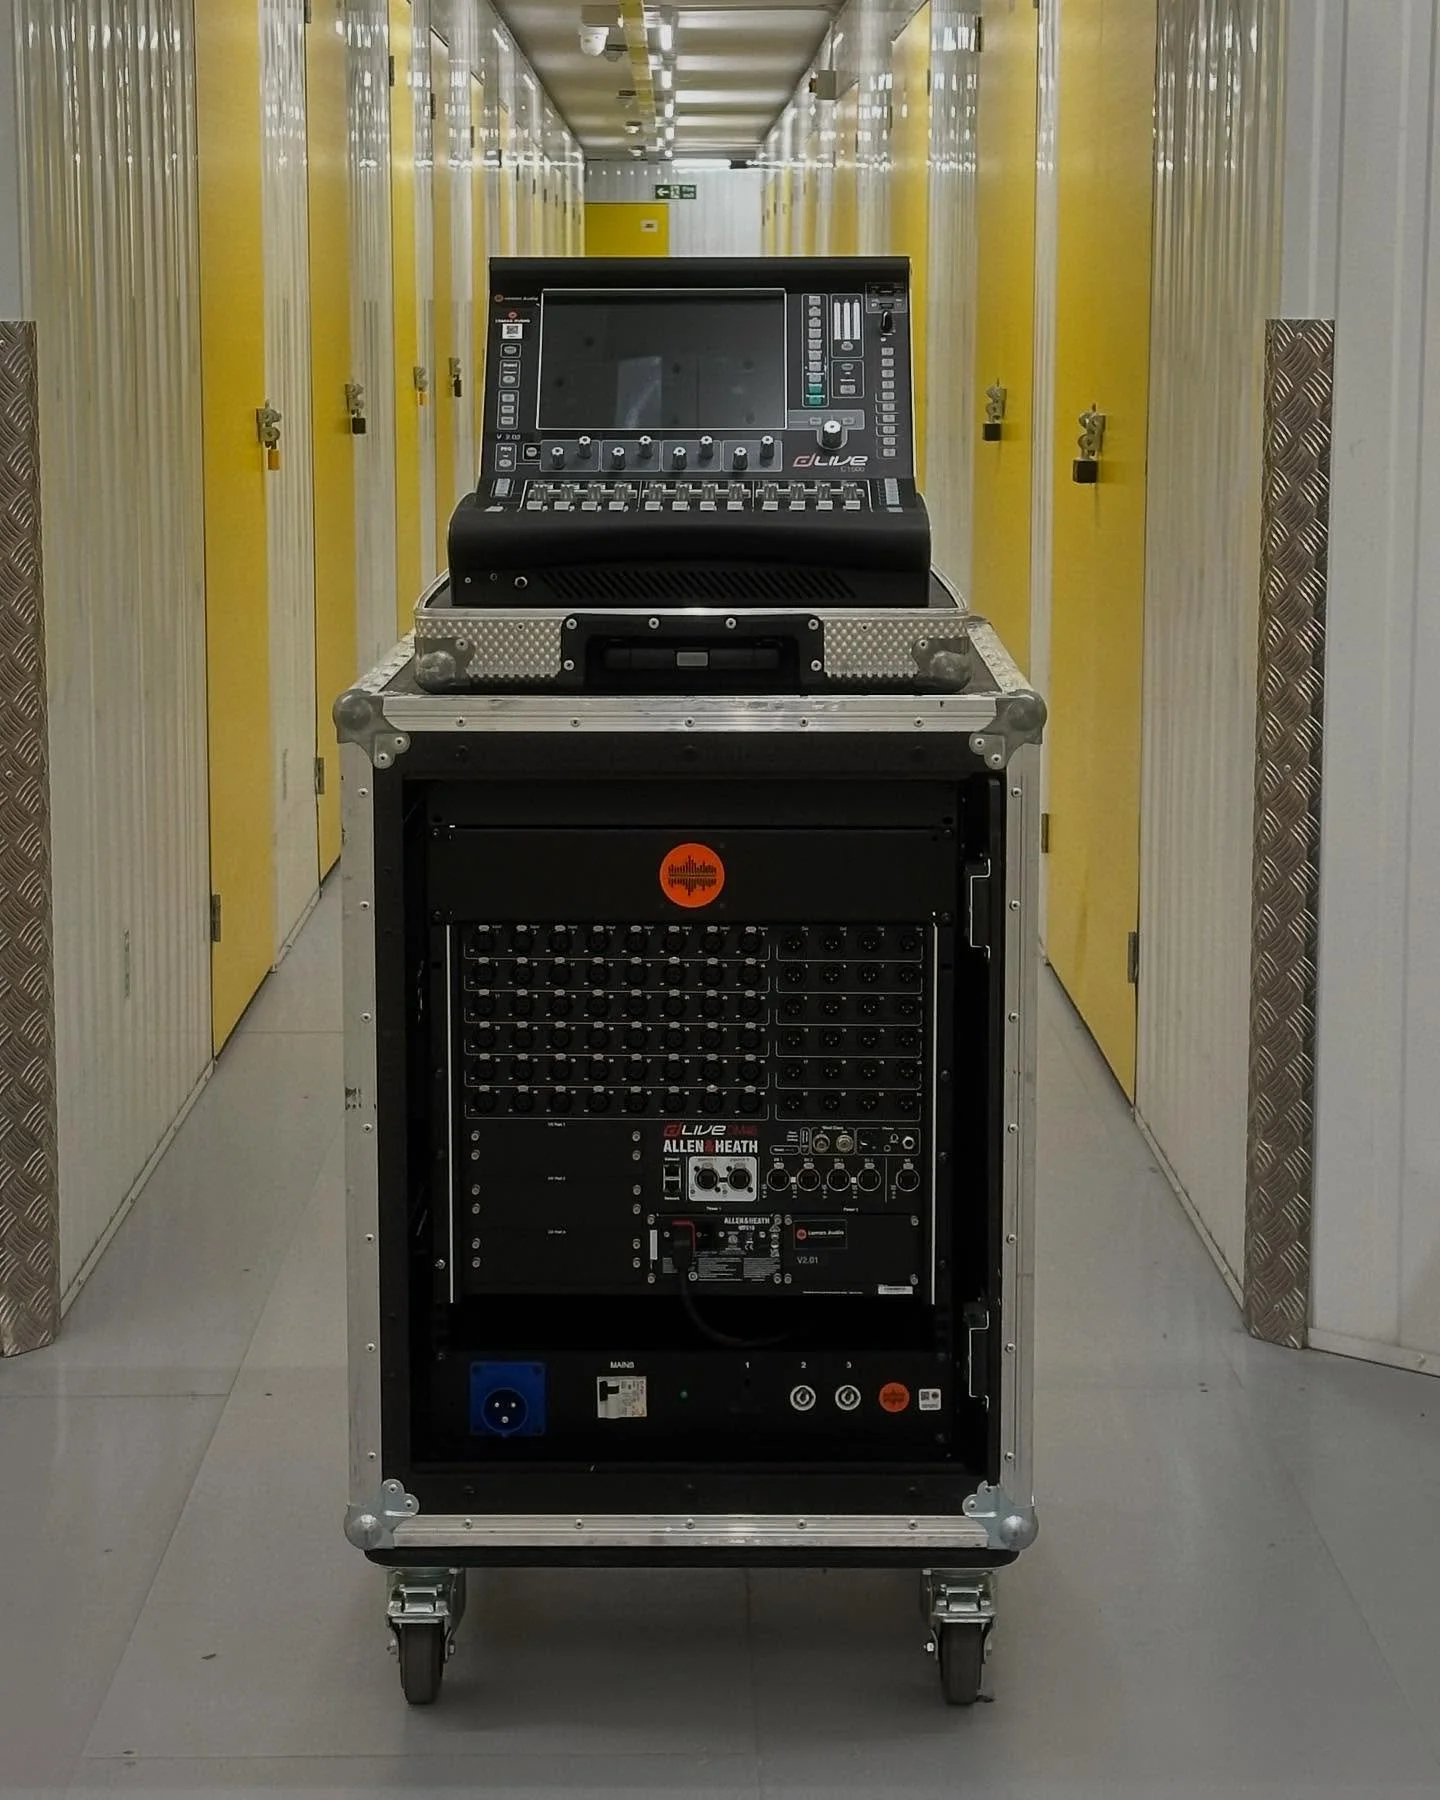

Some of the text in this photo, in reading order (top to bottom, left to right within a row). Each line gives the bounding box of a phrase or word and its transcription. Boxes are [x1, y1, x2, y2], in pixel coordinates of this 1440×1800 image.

[796, 1256, 818, 1264] V2.01
[610, 1360, 635, 1369] MAINS
[800, 1361, 807, 1369] 2
